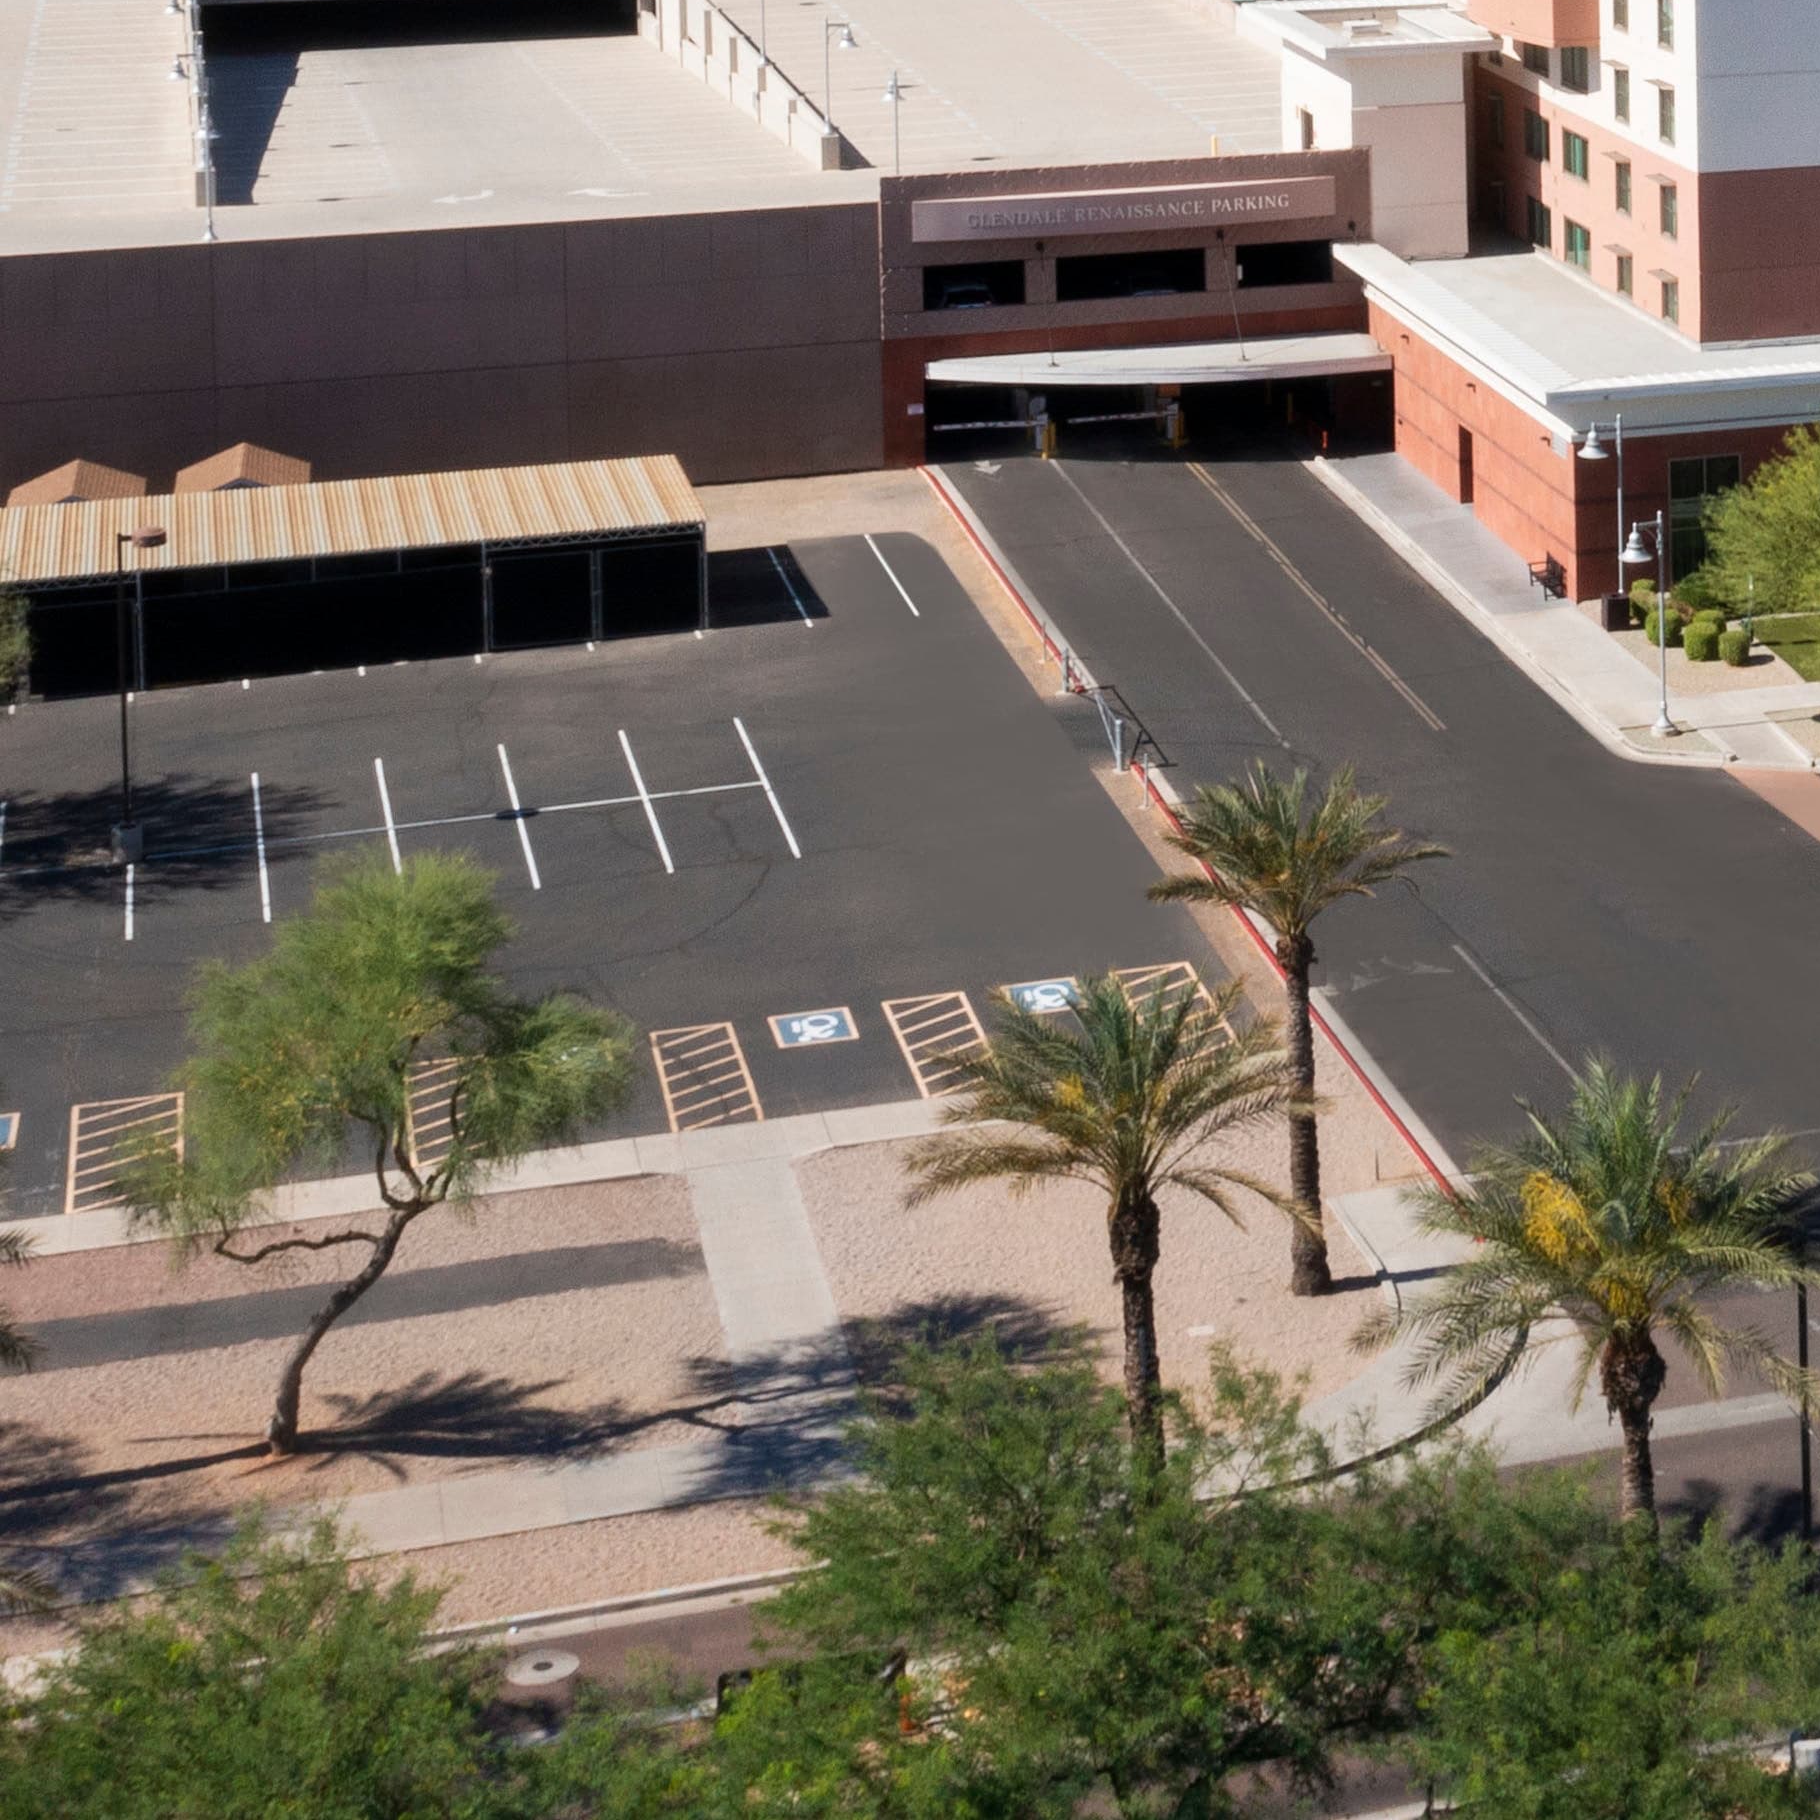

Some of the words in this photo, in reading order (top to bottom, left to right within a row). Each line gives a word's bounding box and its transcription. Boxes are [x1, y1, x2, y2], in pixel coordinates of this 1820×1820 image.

[967, 207, 1067, 229] GLENDALE
[1074, 200, 1205, 222] RENAISSANCE
[1211, 193, 1290, 214] PARKING
